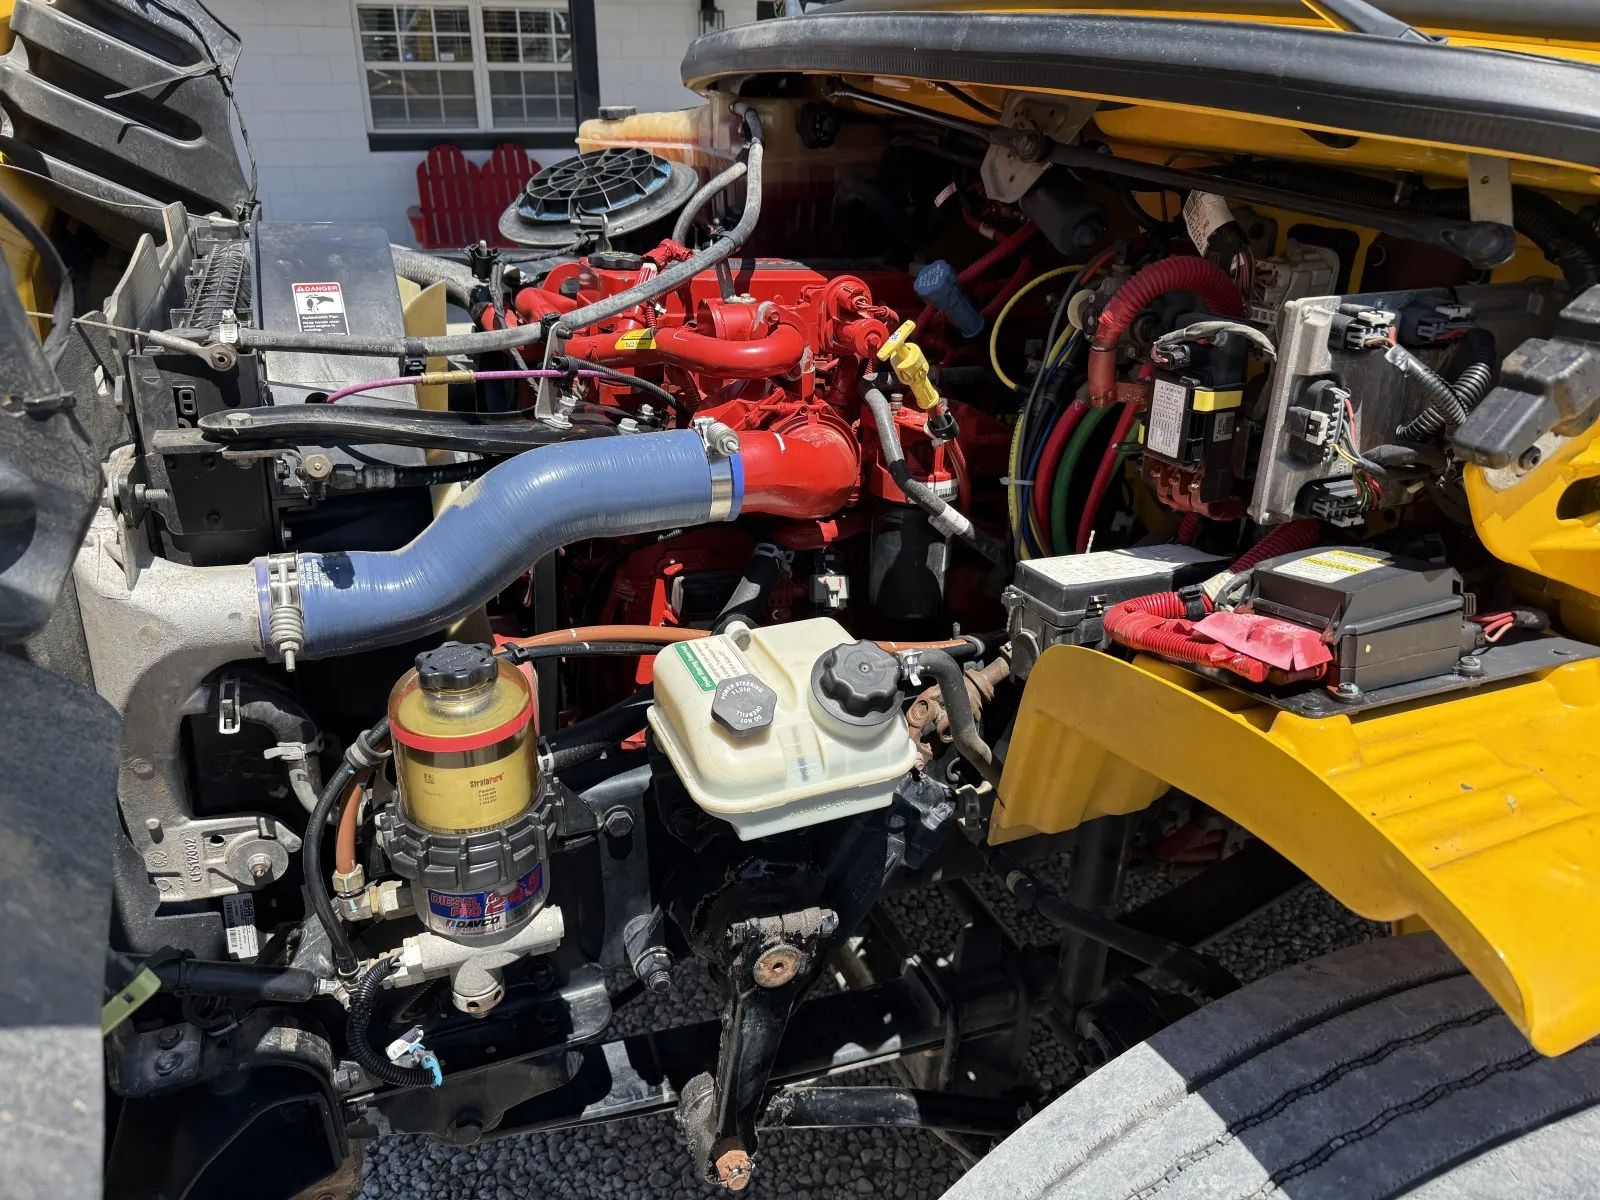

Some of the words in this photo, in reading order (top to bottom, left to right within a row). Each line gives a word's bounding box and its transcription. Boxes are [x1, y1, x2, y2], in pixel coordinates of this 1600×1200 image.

[720, 684, 735, 700] POWER
[735, 680, 764, 694] STEERING
[731, 687, 751, 695] FLUID
[736, 705, 762, 718] OVERFILL
[753, 714, 762, 722] DO
[430, 892, 480, 907] DIESEL
[450, 906, 482, 917] PRO
[455, 916, 500, 929] DAVCO
